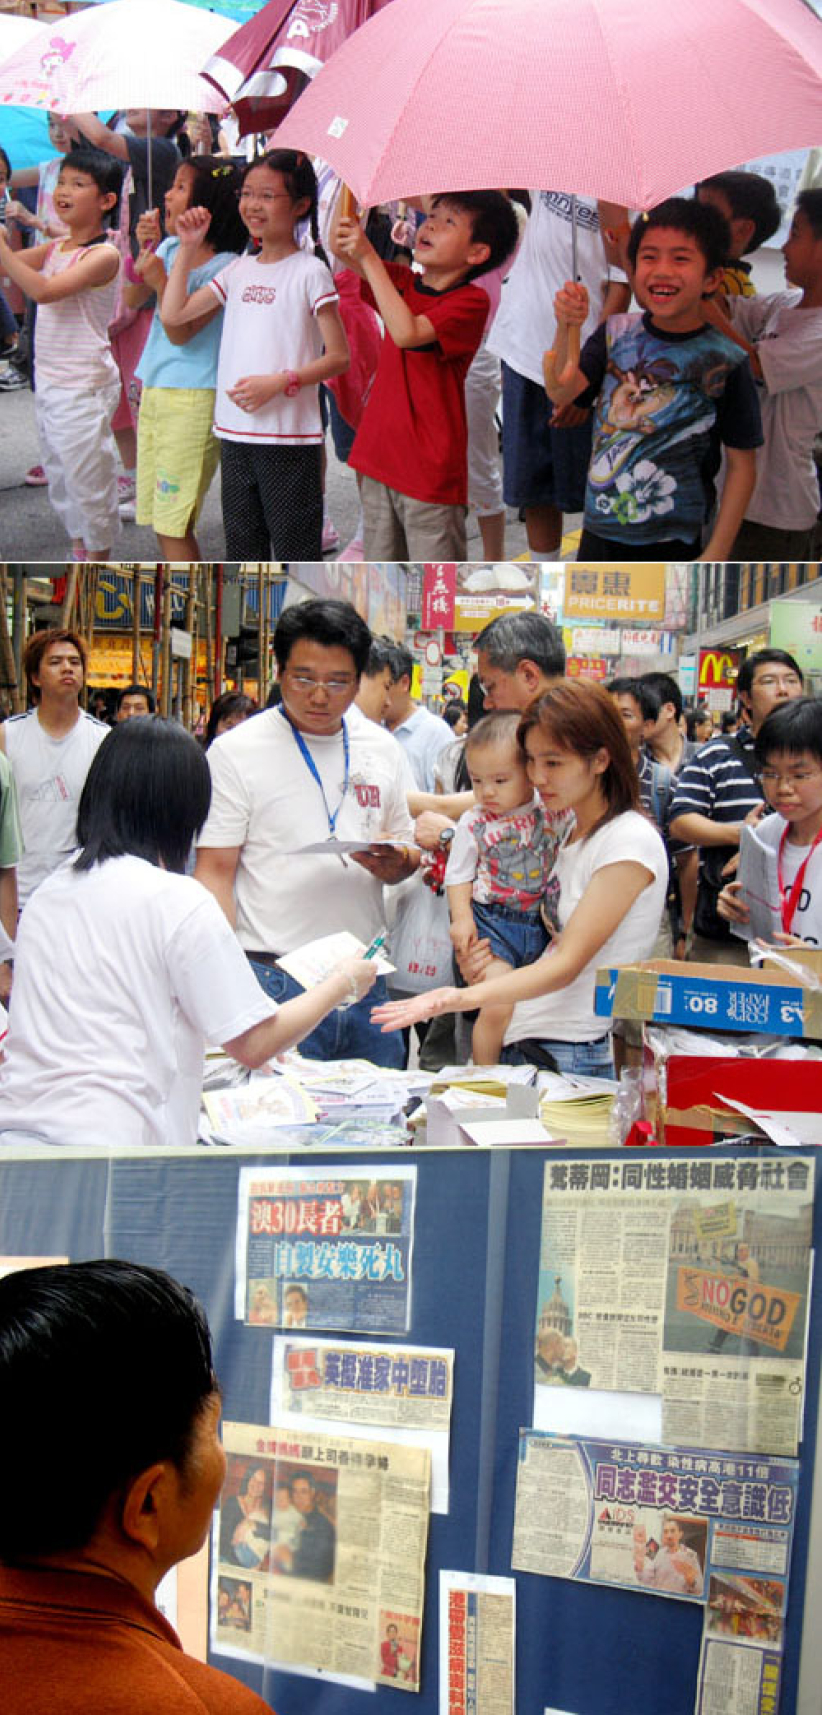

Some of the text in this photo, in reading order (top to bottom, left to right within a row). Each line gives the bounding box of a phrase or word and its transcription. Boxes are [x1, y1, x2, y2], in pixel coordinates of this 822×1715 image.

[567, 596, 661, 614] PRICERITE
[690, 997, 718, 1015] 80
[730, 1287, 787, 1327] GOD
